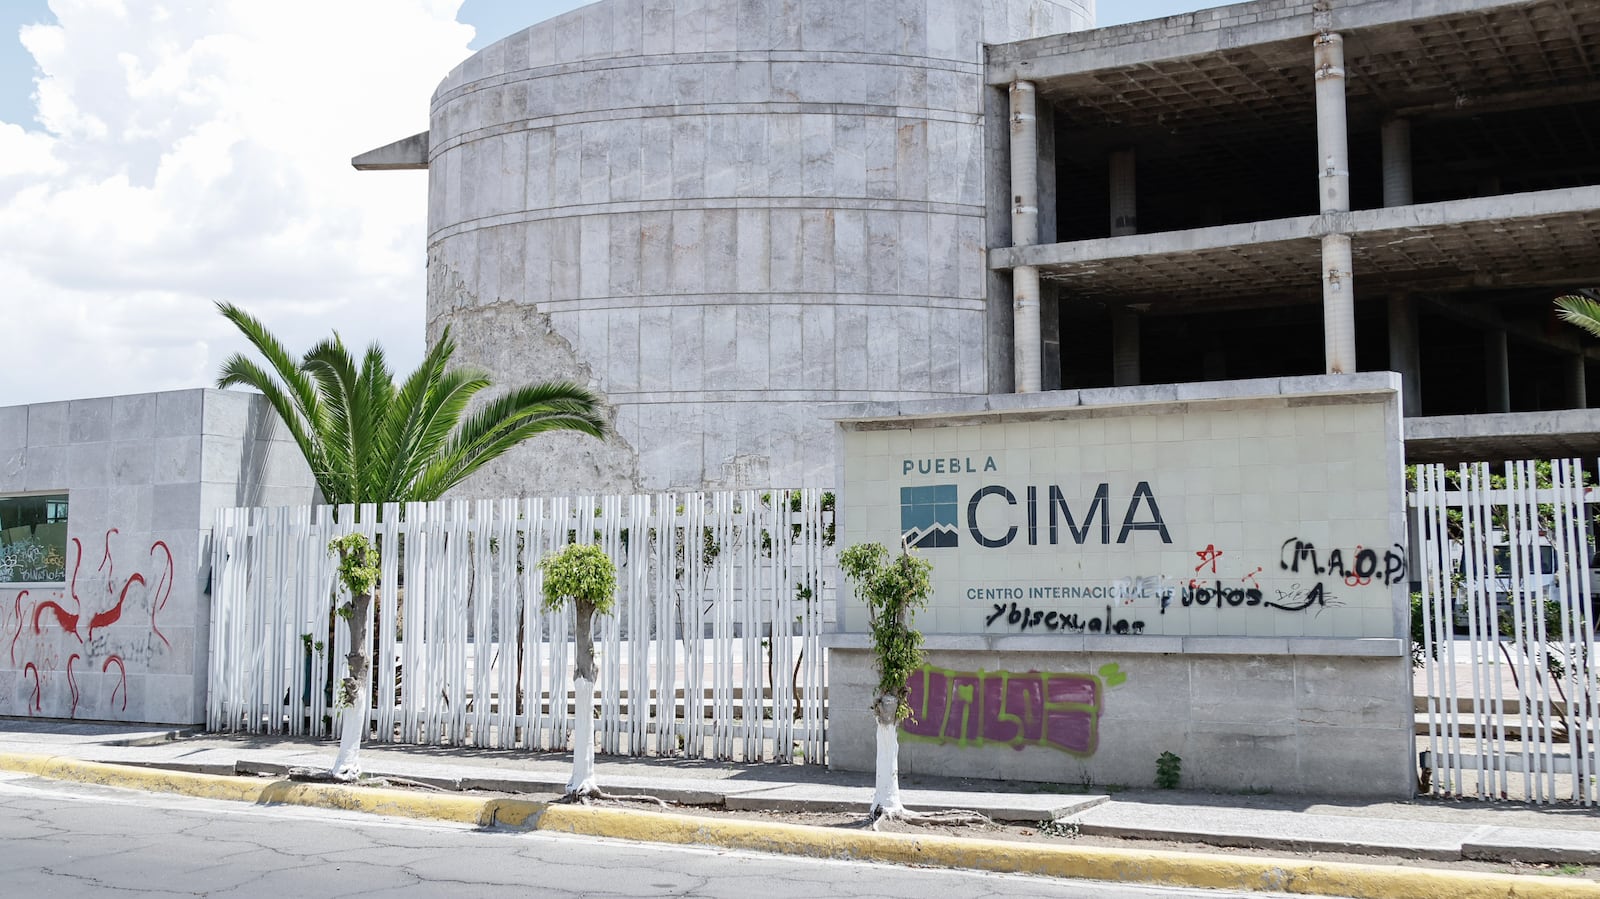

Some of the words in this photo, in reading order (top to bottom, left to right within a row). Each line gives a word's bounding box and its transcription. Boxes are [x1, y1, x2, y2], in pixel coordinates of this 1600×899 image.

[903, 456, 998, 475] PUEBLA
[967, 481, 1173, 548] CIMA
[967, 588, 1024, 600] CENTRO
